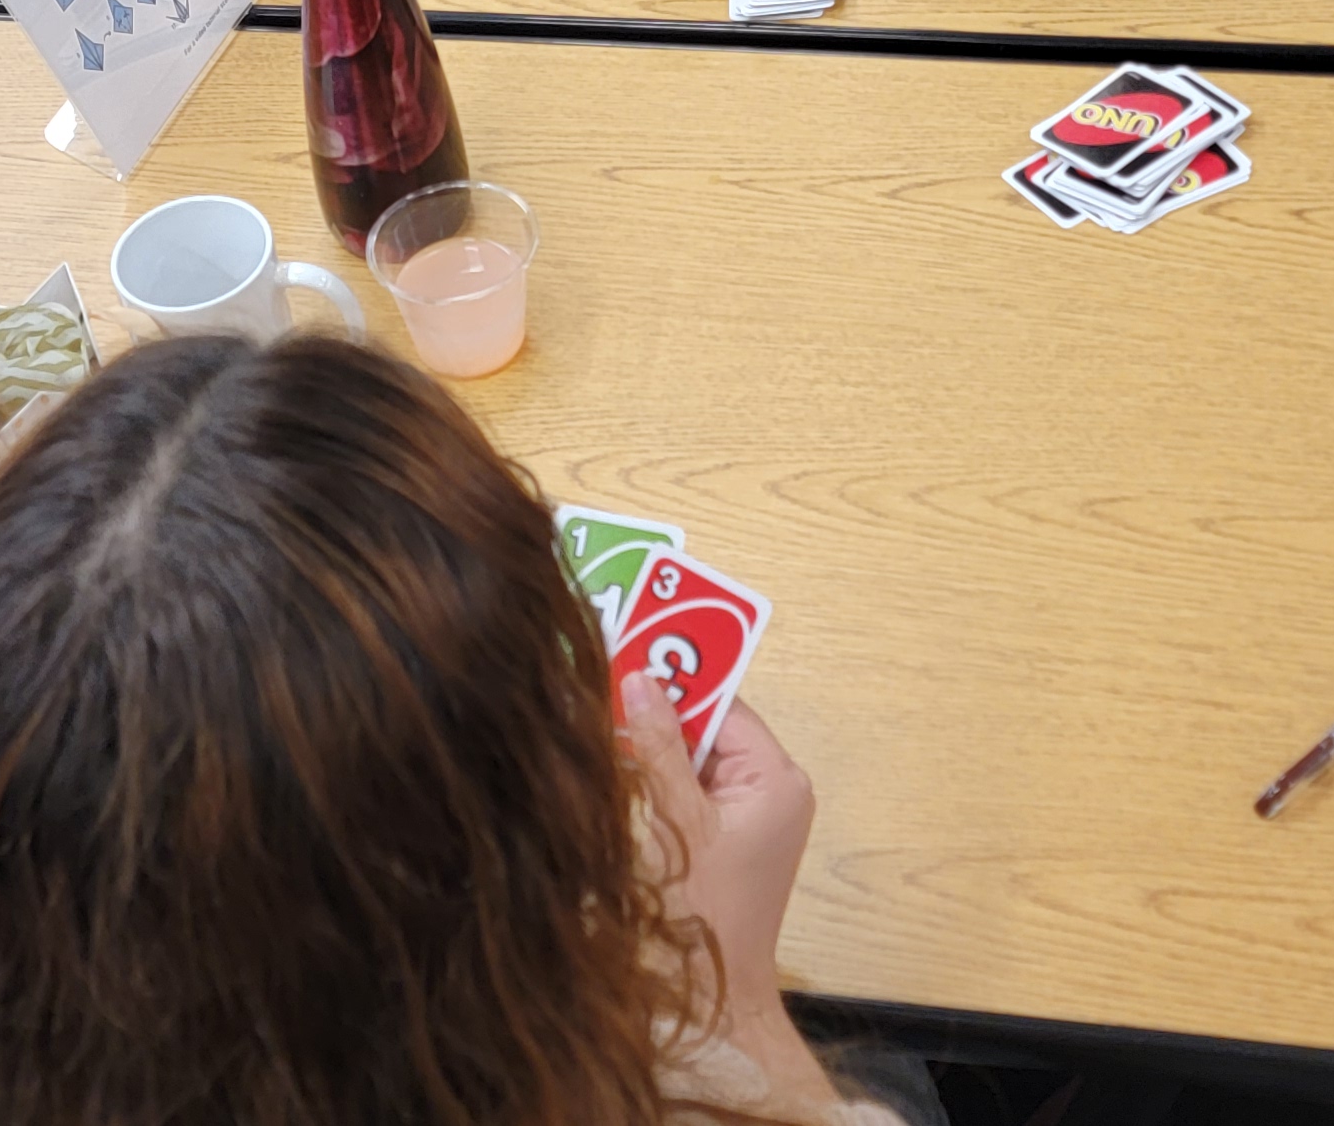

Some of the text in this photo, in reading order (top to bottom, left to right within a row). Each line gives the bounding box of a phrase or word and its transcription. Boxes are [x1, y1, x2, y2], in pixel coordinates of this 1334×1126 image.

[1072, 101, 1160, 139] UNO
[571, 524, 588, 559] 1
[651, 565, 682, 601] 3
